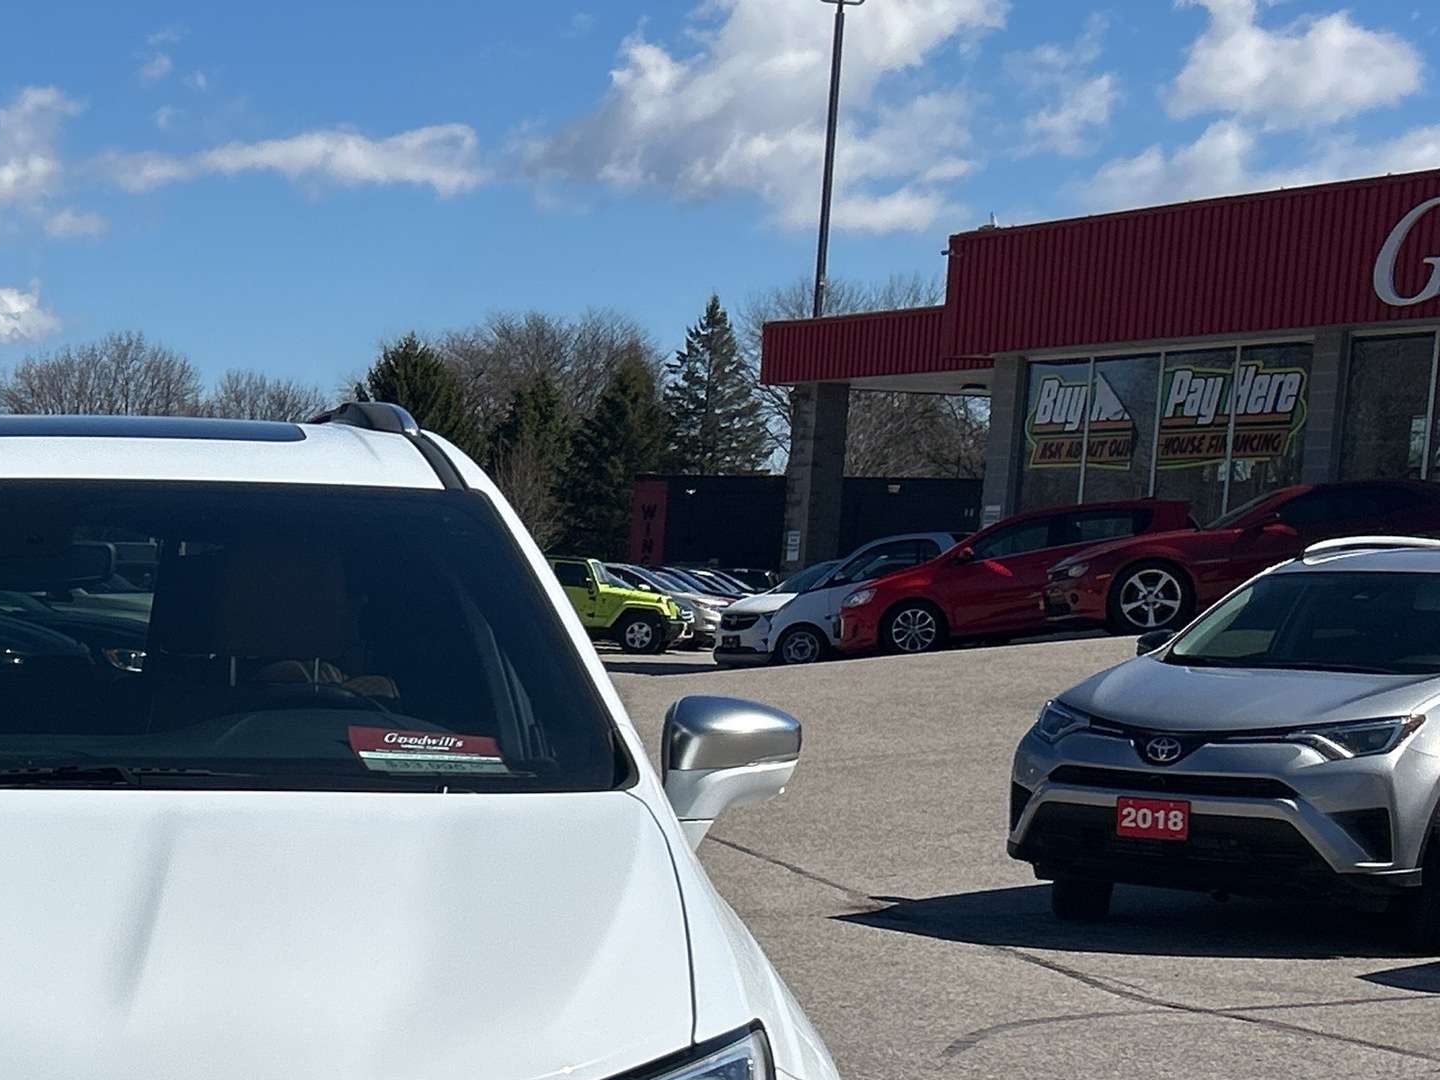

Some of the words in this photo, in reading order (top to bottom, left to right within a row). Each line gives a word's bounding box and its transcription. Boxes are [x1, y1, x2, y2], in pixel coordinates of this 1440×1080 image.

[1034, 379, 1088, 432] Buy
[1164, 370, 1225, 425] Pay
[1223, 364, 1301, 415] Here
[1039, 442, 1064, 460] ASK
[1065, 439, 1109, 459] ABUT
[1206, 432, 1281, 454] FINNCING
[384, 732, 464, 748] Goodwill's
[1121, 807, 1184, 831] 2018
